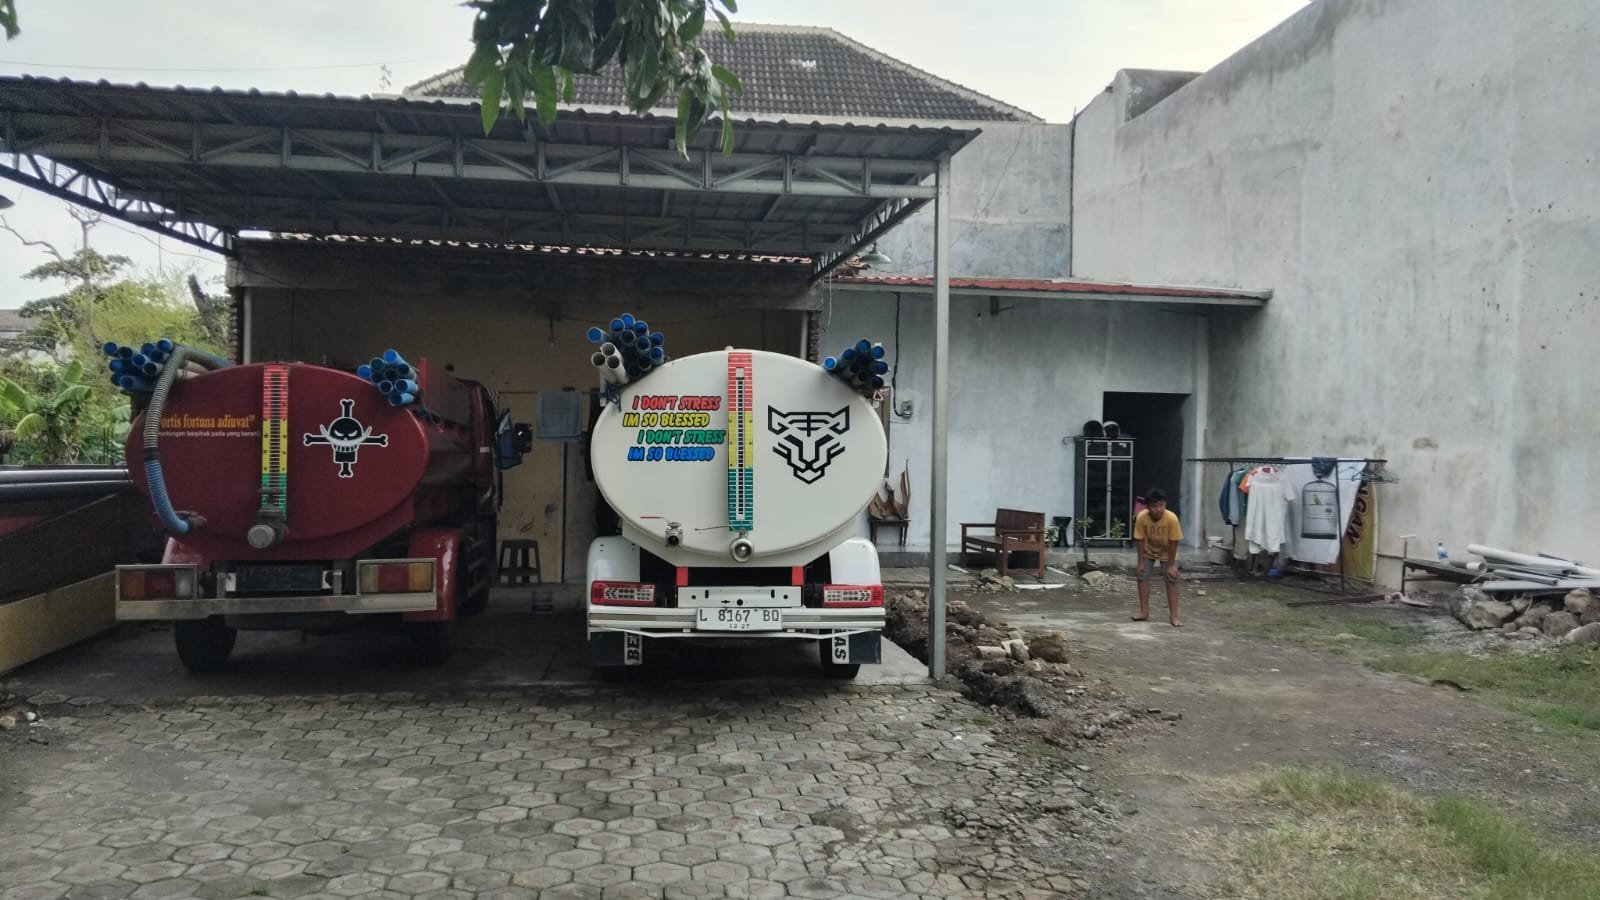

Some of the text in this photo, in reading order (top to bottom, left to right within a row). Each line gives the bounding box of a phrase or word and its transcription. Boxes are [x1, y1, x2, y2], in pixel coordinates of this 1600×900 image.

[632, 395, 721, 411] I DON'T STRESS
[161, 414, 181, 428] ortis
[183, 414, 215, 428] fortuna
[623, 412, 710, 427] IM SO BLESSED
[637, 430, 726, 445] I DON'T STRESS
[628, 446, 715, 461] IM SO BLESSED
[700, 609, 708, 622] L
[718, 609, 750, 622] 8167
